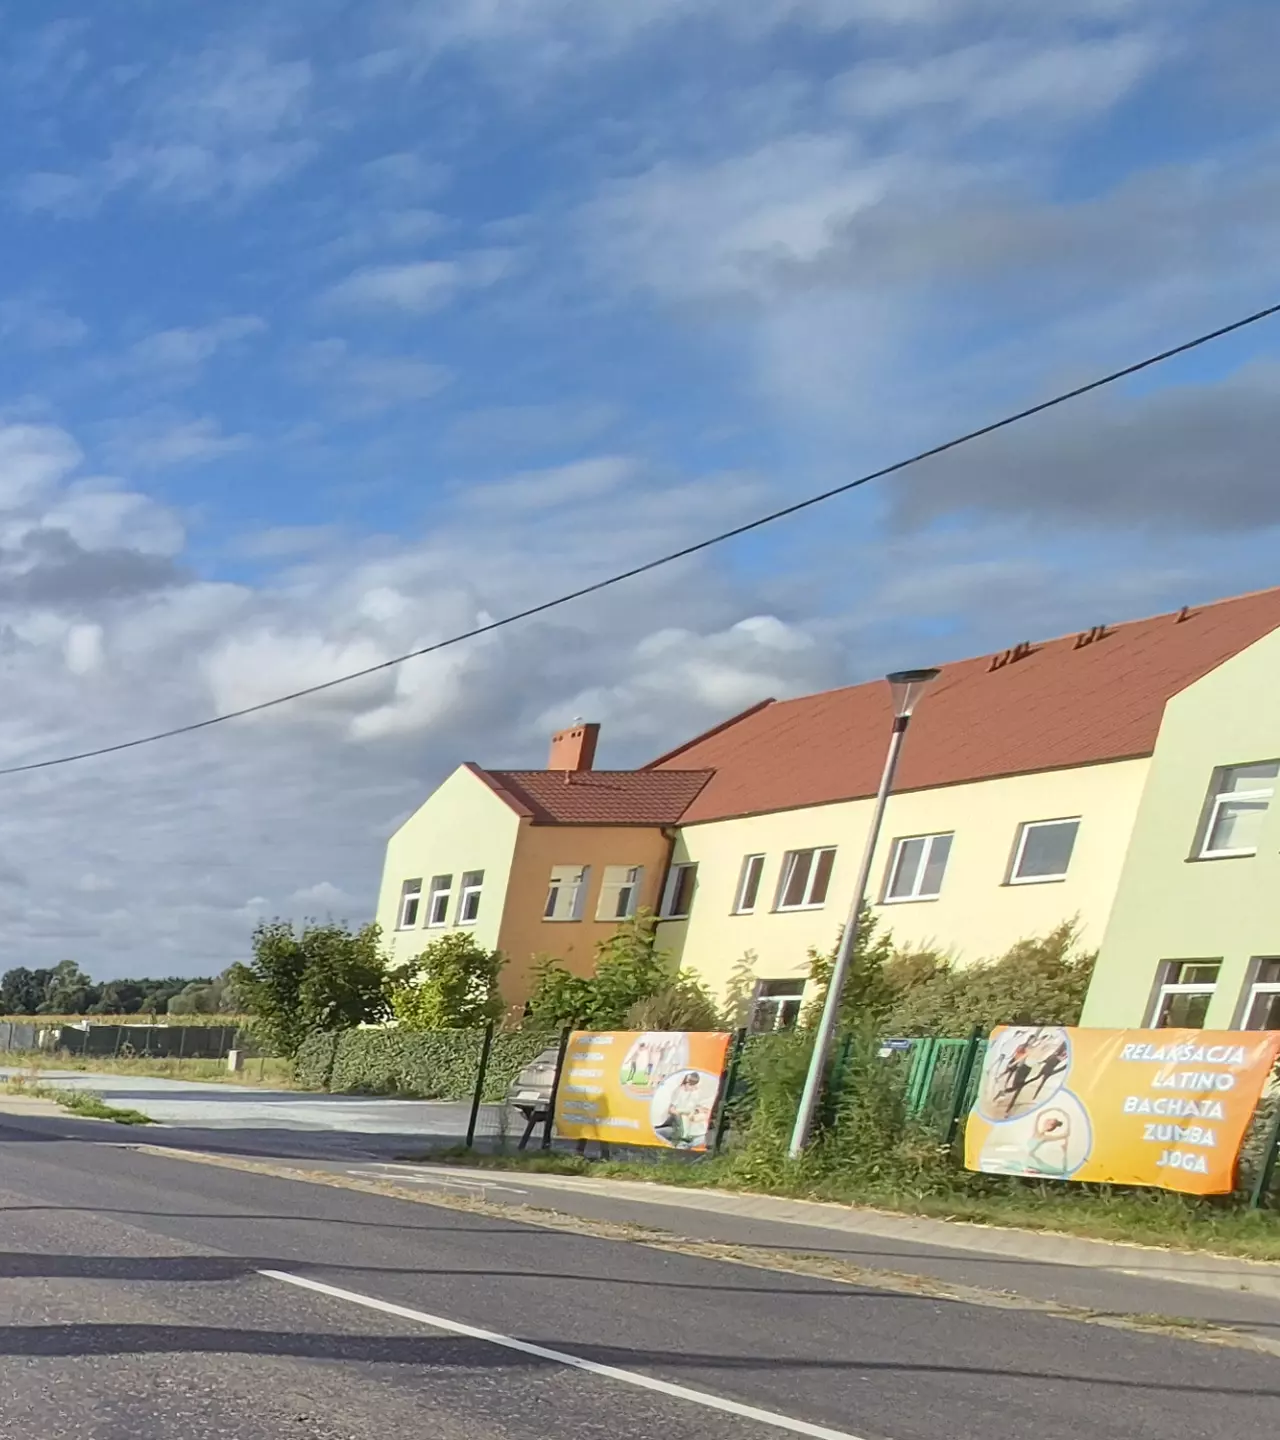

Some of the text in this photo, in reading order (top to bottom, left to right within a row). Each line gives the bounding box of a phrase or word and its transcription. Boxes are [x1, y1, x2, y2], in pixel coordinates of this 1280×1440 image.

[1121, 1043, 1244, 1064] RELAKSACJA
[1151, 1072, 1236, 1092] LATINO
[1123, 1096, 1224, 1120] BACHATA
[1142, 1124, 1216, 1147] ZUMBA
[1156, 1150, 1208, 1173] JOGA
